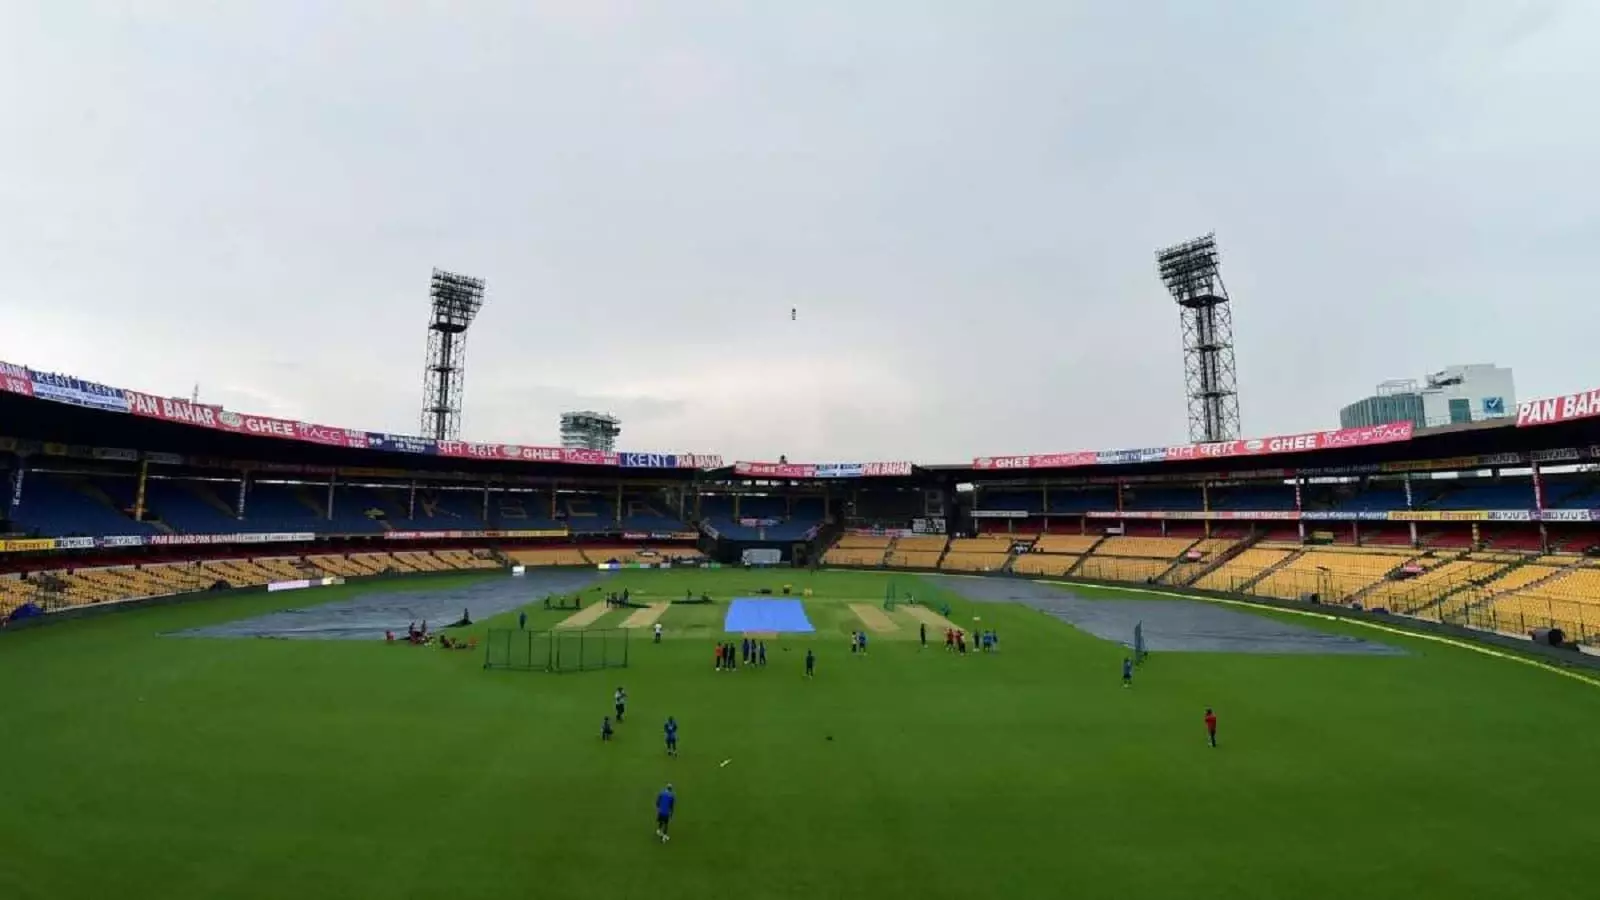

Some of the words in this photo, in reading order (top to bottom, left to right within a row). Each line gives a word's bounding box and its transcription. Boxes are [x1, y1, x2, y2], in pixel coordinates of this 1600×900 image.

[126, 391, 160, 415] PAN
[163, 398, 216, 426] BAHAR
[1517, 397, 1557, 425] PAN
[246, 418, 296, 436] GHEE
[1269, 434, 1317, 451] GHEE
[523, 448, 560, 460] GHEE
[626, 453, 668, 467] KENT
[996, 457, 1029, 468] GHEE
[151, 535, 168, 545] PAN
